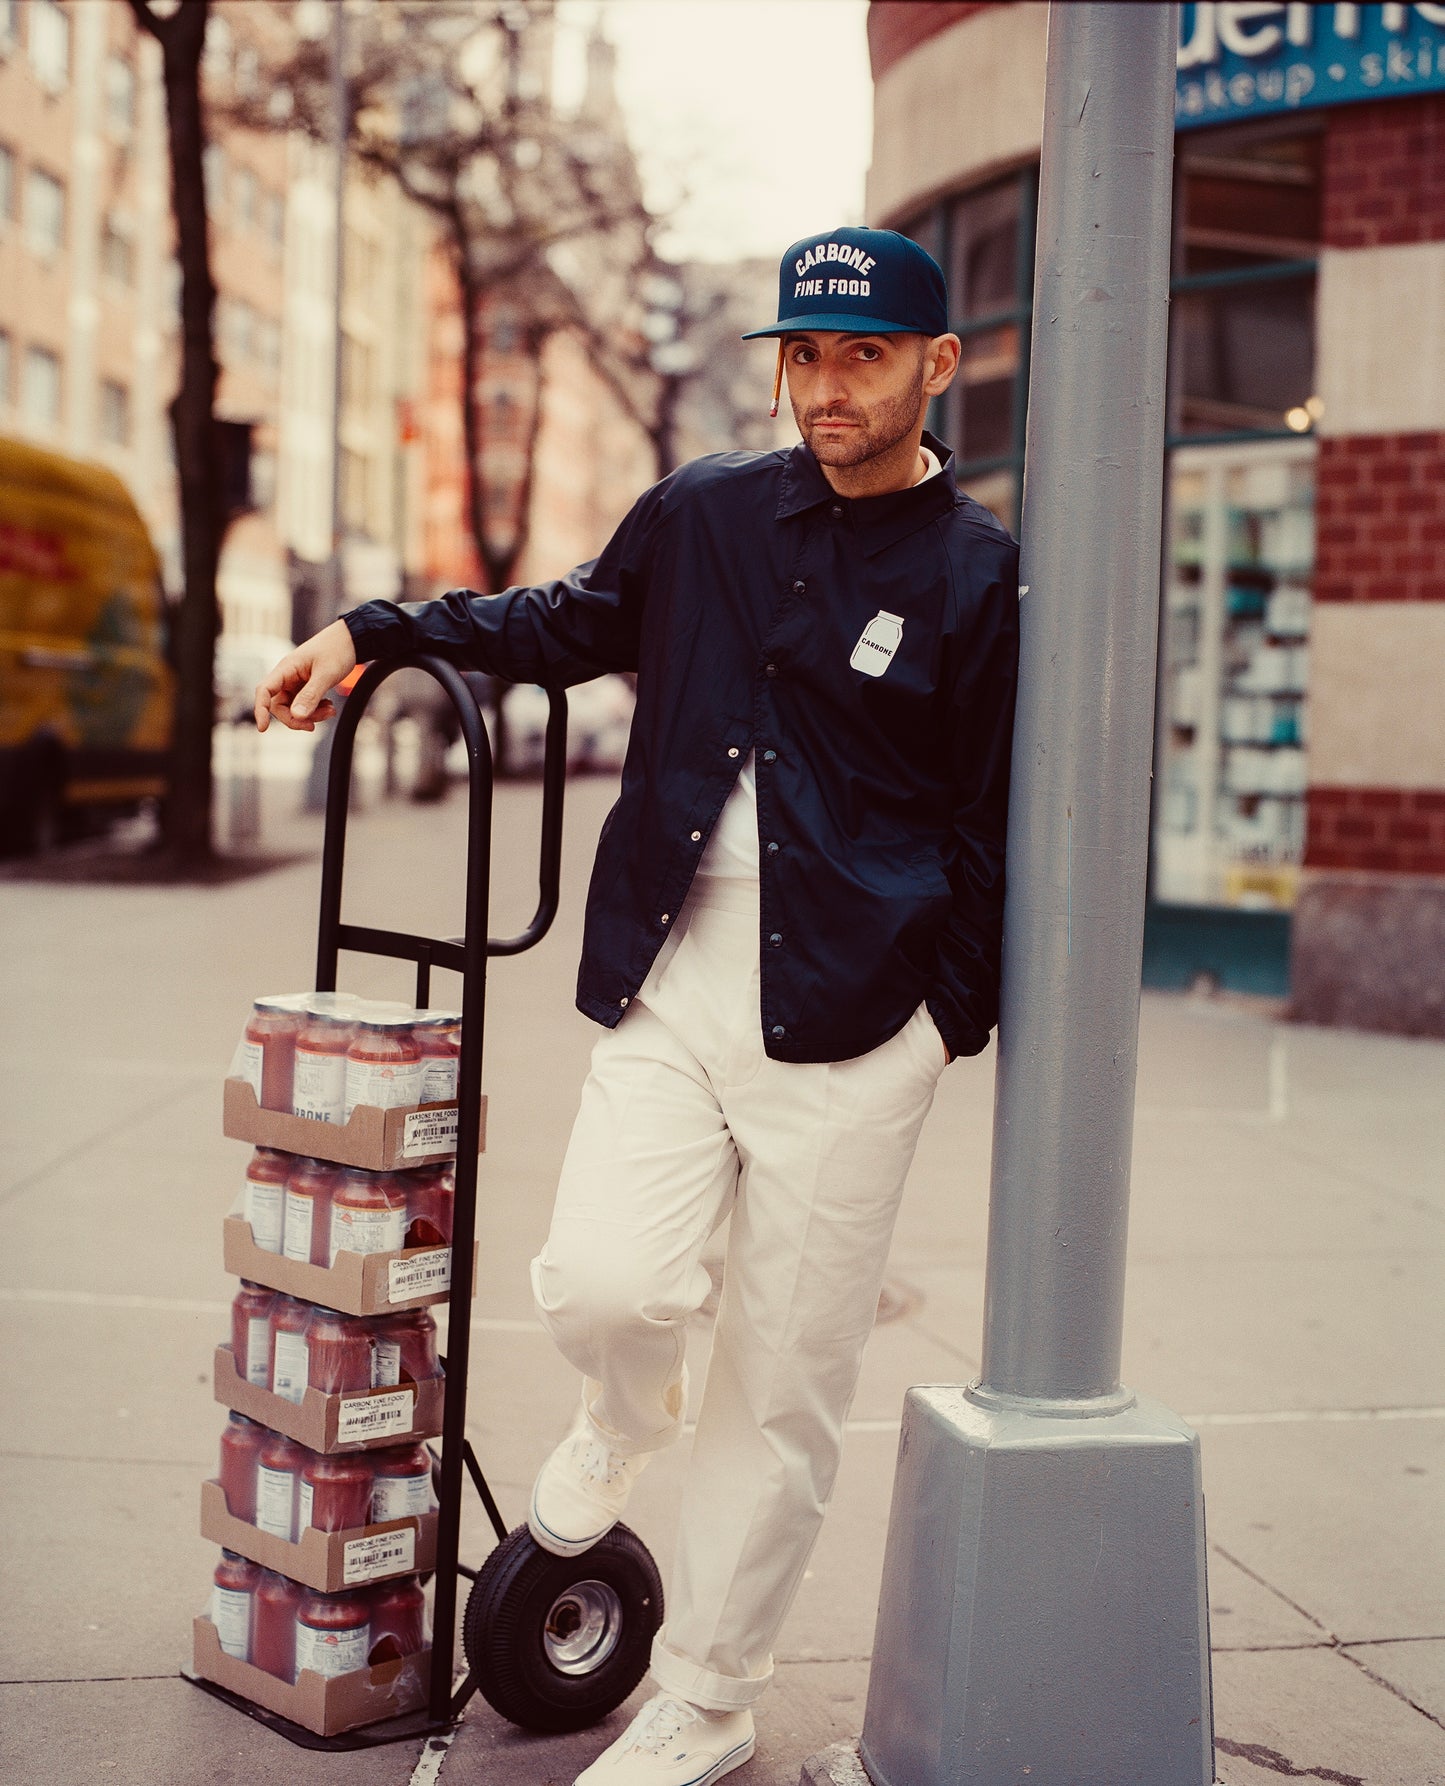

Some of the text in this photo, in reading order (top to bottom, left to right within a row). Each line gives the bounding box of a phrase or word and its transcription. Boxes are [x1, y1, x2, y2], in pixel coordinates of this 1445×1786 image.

[1176, 63, 1315, 115] akeup
[795, 243, 877, 277] CARBONE
[794, 278, 871, 298] FINE FOOD
[861, 637, 893, 657] CARBONE
[408, 1112, 431, 1121] CARBONE
[344, 1399, 371, 1409] CARBONE
[387, 1394, 405, 1402] FOOD
[347, 1538, 374, 1550] CARBONE
